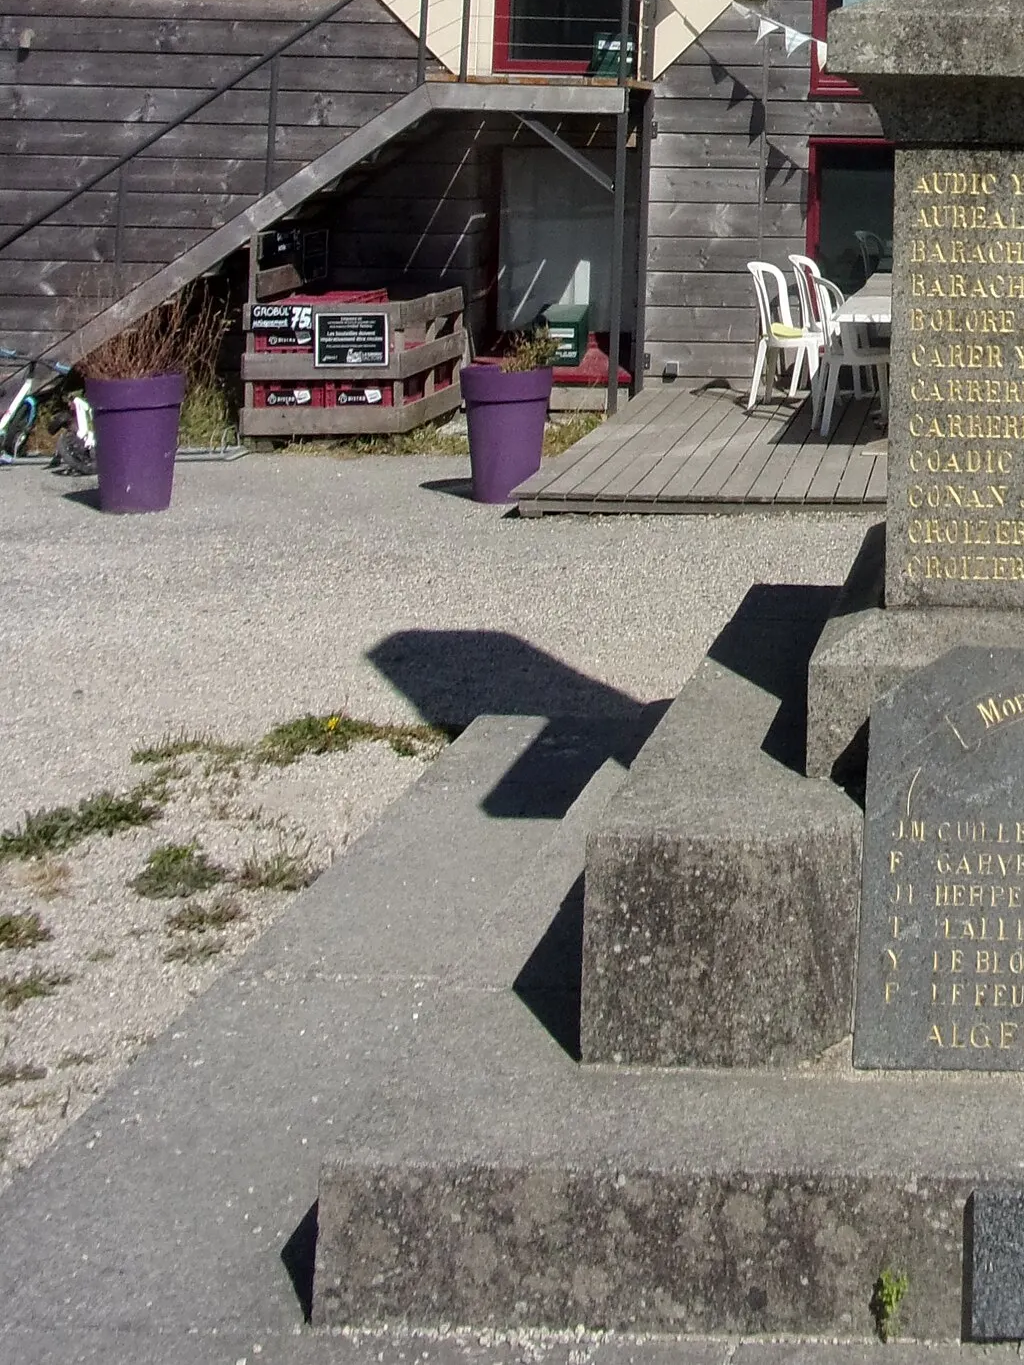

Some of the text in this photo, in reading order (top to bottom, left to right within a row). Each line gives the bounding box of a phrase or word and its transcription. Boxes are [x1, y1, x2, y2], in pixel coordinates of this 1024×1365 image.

[912, 172, 996, 195] AUDIC
[913, 205, 1024, 229] AUREAL
[910, 309, 1015, 333] BOLORE
[911, 344, 1003, 368] CARER
[909, 449, 1012, 474] COADIC
[909, 485, 1007, 508] CONAN
[889, 851, 904, 874] F
[936, 884, 1022, 908] HERPE
[886, 948, 903, 970] Y
[933, 950, 963, 974] LE
